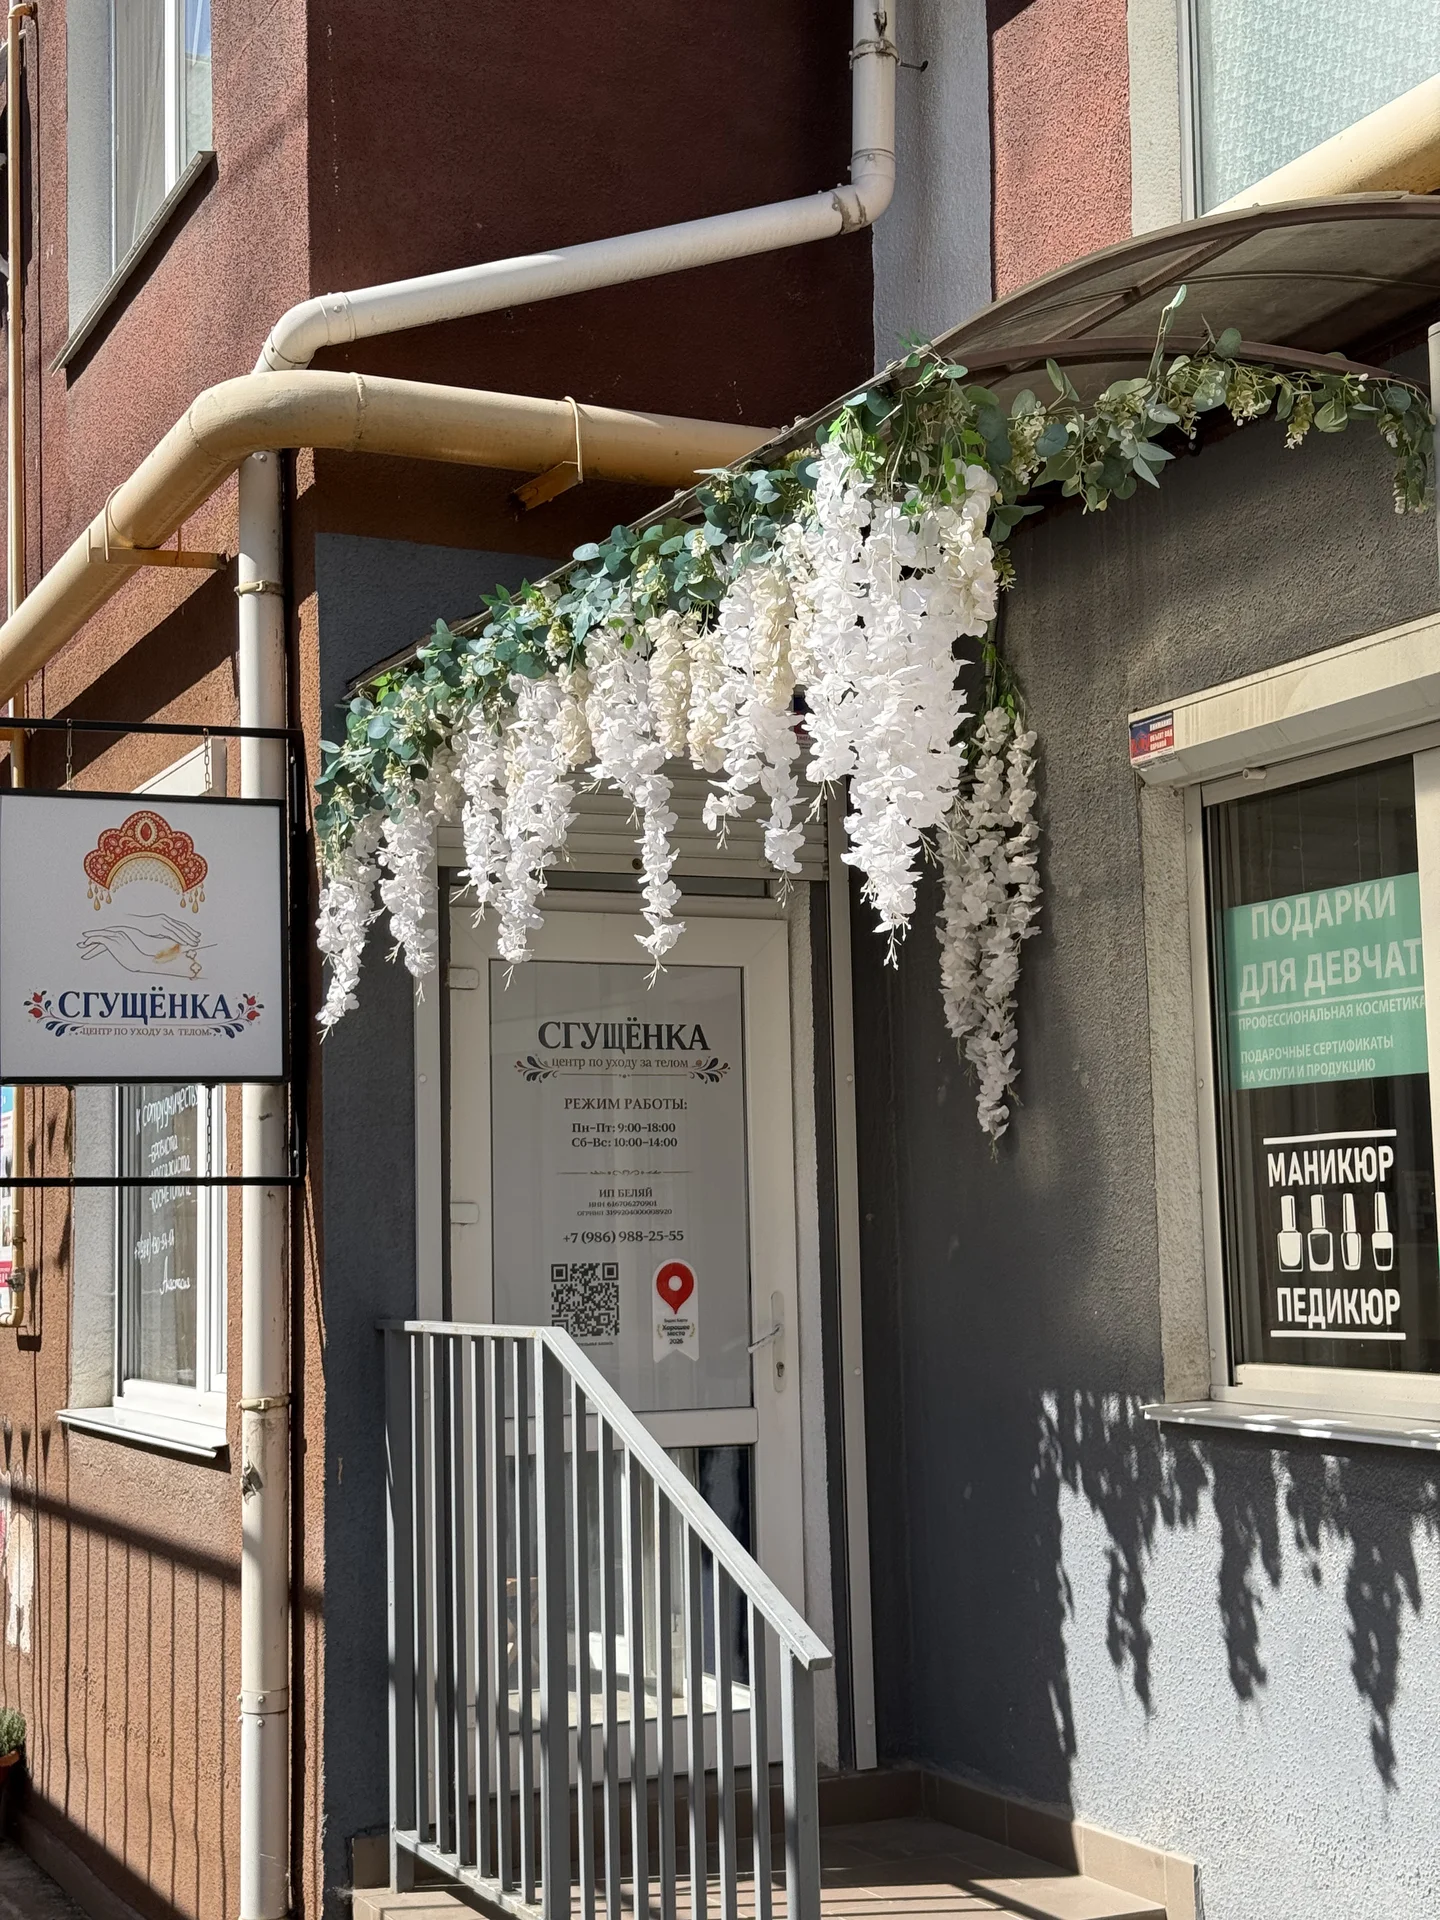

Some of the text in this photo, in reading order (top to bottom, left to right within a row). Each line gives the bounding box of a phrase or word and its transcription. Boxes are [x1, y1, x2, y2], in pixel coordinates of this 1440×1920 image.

[1251, 880, 1396, 941] ПОДАРКИ
[1239, 937, 1422, 1007] ДЛЯ ДЕВЧАТ
[58, 986, 234, 1025] СГУЩЁНКА
[1238, 1004, 1352, 1031] ПРОФЕССИОНАЛЬНАЯ
[82, 1027, 211, 1036] ЦЕНТР ПО УХОДУ ЗА ТЕЛОМ
[538, 1017, 711, 1054] СГУЩЁНКА
[1240, 1034, 1394, 1064] ПОДАРОЧНЫЕ СЕРТИФИКАТЫ
[551, 1058, 689, 1070] центр по уходу за телом
[1241, 1057, 1376, 1083] НА УСЛУГИ И ПРОДУКЦИЮ
[564, 1098, 688, 1110] РЕЖИМ РАБОТЫ:
[1267, 1145, 1394, 1188] МАНИКЮР
[599, 1187, 653, 1198] ИП БЕЛЯЙ
[563, 1230, 685, 1244] +7 (986) 988-25-55
[1277, 1287, 1401, 1330] ПЕДИКЮР
